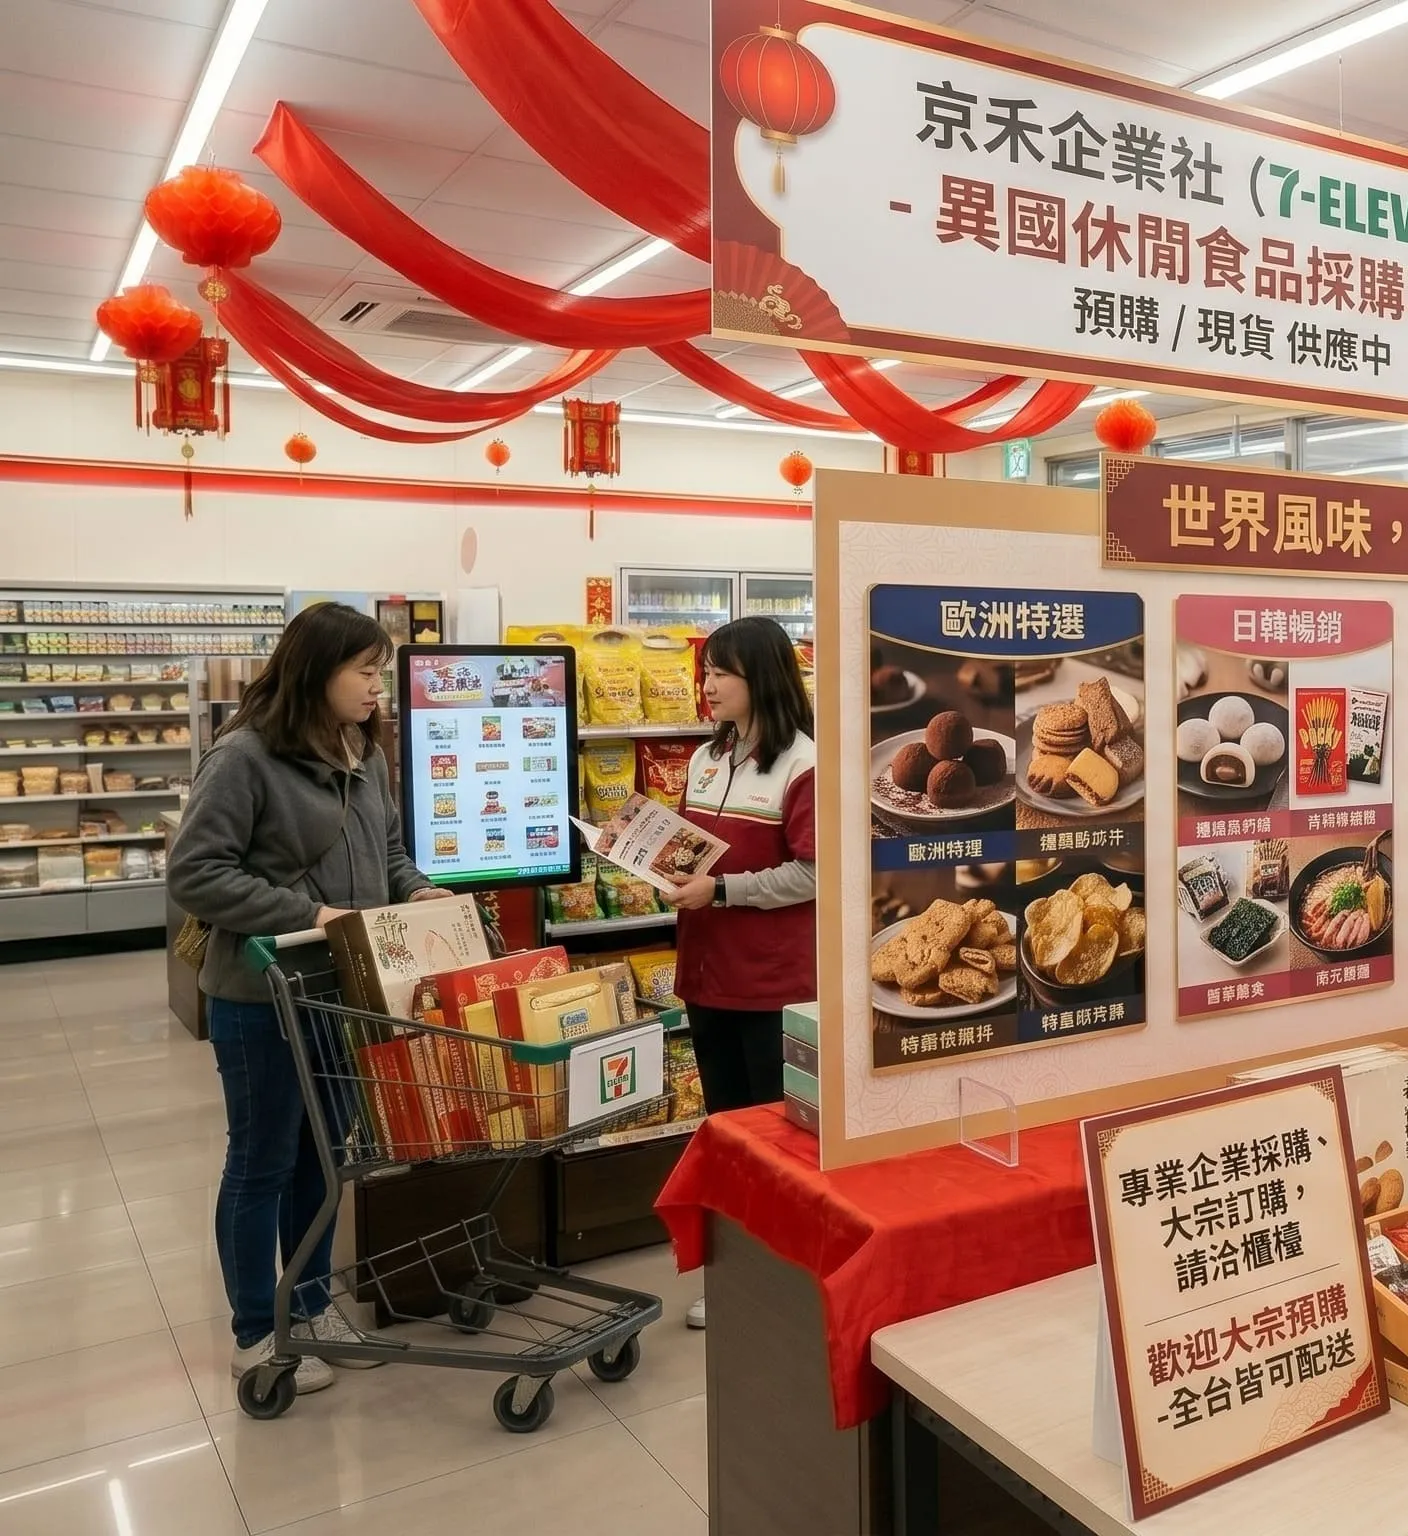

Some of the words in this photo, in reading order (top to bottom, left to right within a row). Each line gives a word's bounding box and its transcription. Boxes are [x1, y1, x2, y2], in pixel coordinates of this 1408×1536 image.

[914, 79, 1224, 207] 京禾企業社
[1073, 286, 1160, 345] 預購
[1198, 306, 1275, 362] 現貨
[1286, 321, 1392, 376] 供應中
[940, 600, 1086, 641] 歐洲特選
[1232, 608, 1343, 644] 日韓暢銷
[1118, 1127, 1328, 1208] 專業企業採購、
[1160, 1177, 1305, 1248] 大宗訂購，
[1173, 1220, 1305, 1293] 請洽櫃檯
[1146, 1282, 1350, 1388] 歡迎大宗預購
